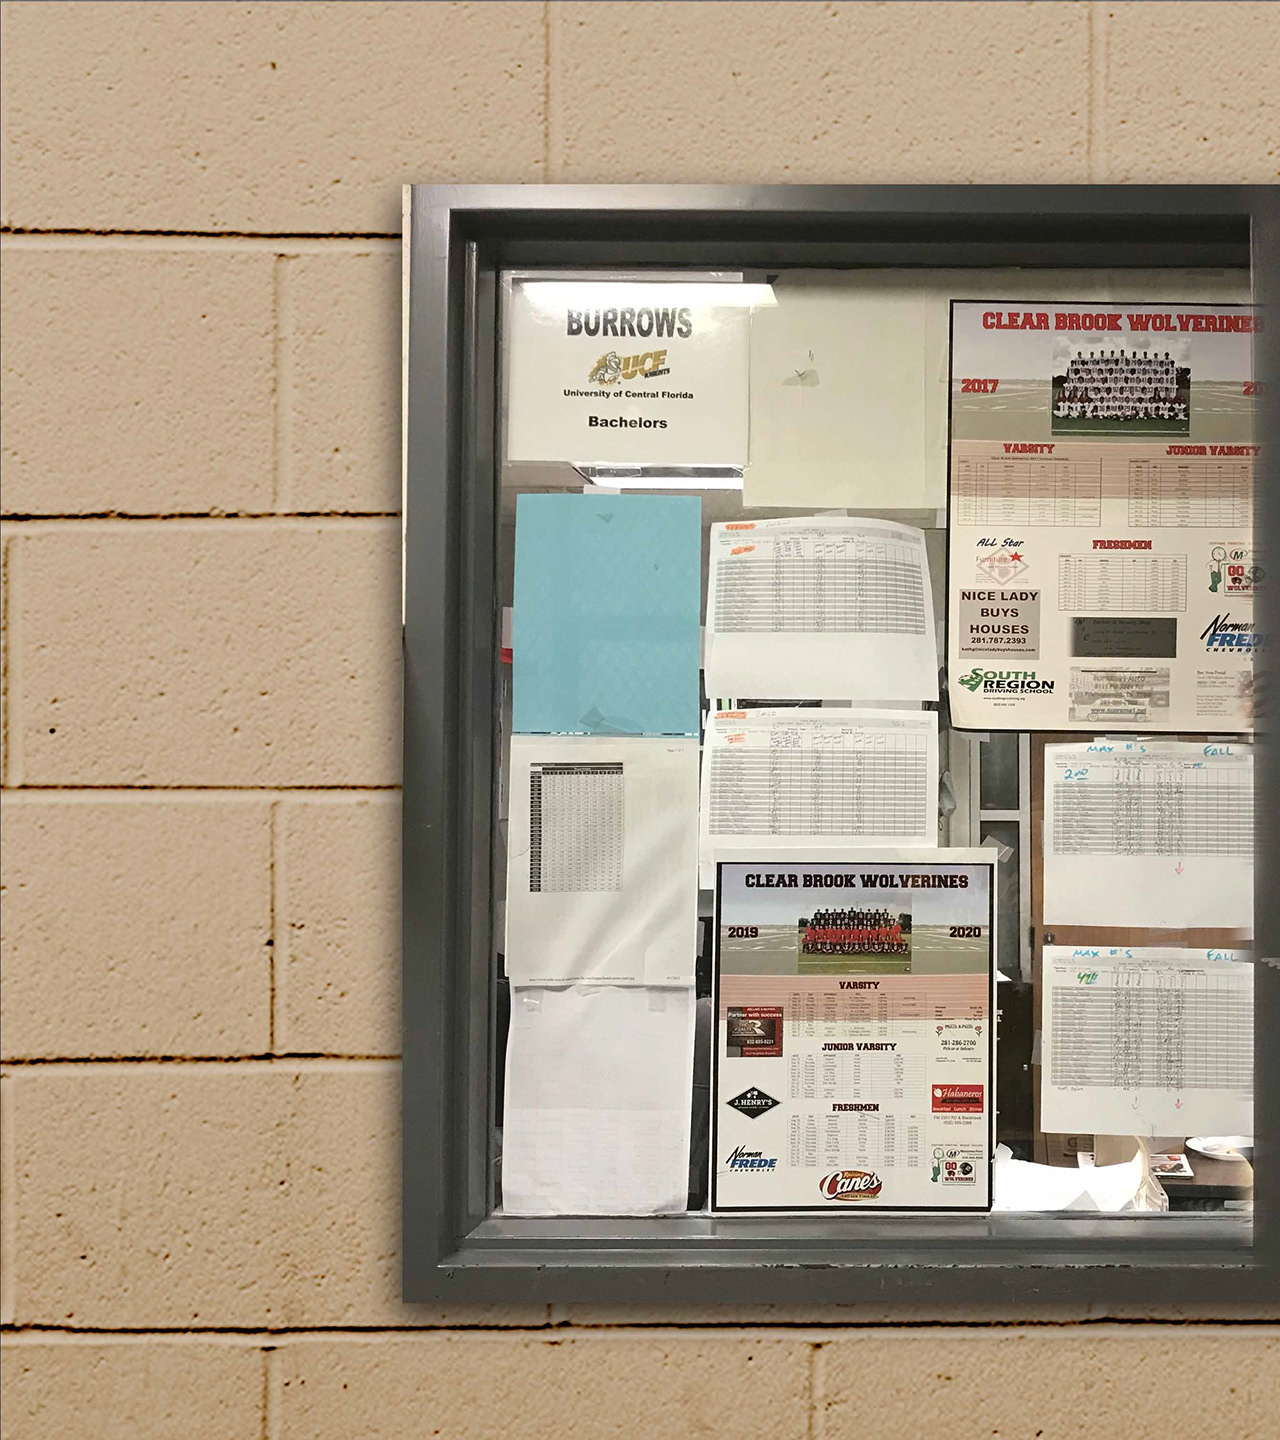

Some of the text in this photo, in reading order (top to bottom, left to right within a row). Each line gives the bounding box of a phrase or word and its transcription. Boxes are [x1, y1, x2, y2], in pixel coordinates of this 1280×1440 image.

[567, 308, 692, 338] BURROWS
[983, 312, 1050, 331] CLEAR
[1054, 312, 1122, 331] BROOK
[621, 350, 667, 379] UCF
[961, 378, 998, 394] 2017
[564, 390, 610, 399] University
[625, 390, 658, 398] Central
[589, 416, 667, 428] Bachelors
[1002, 443, 1055, 454] VARSITY
[1092, 540, 1152, 550] FRESHMEN
[962, 592, 1038, 601] NICE LADY
[981, 608, 1019, 617] BUYS
[970, 625, 1030, 634] HOUSES
[970, 668, 1036, 680] SOUTH
[984, 680, 1054, 689] REGION
[1203, 745, 1234, 756] FALL
[745, 874, 968, 888] CLEAR BROOK WOLVERINES
[728, 927, 759, 938] 2019
[949, 926, 981, 938] 2020
[822, 1043, 854, 1051] JUNIOR
[730, 1159, 777, 1168] FREDE
[823, 1172, 882, 1200] Cane's
